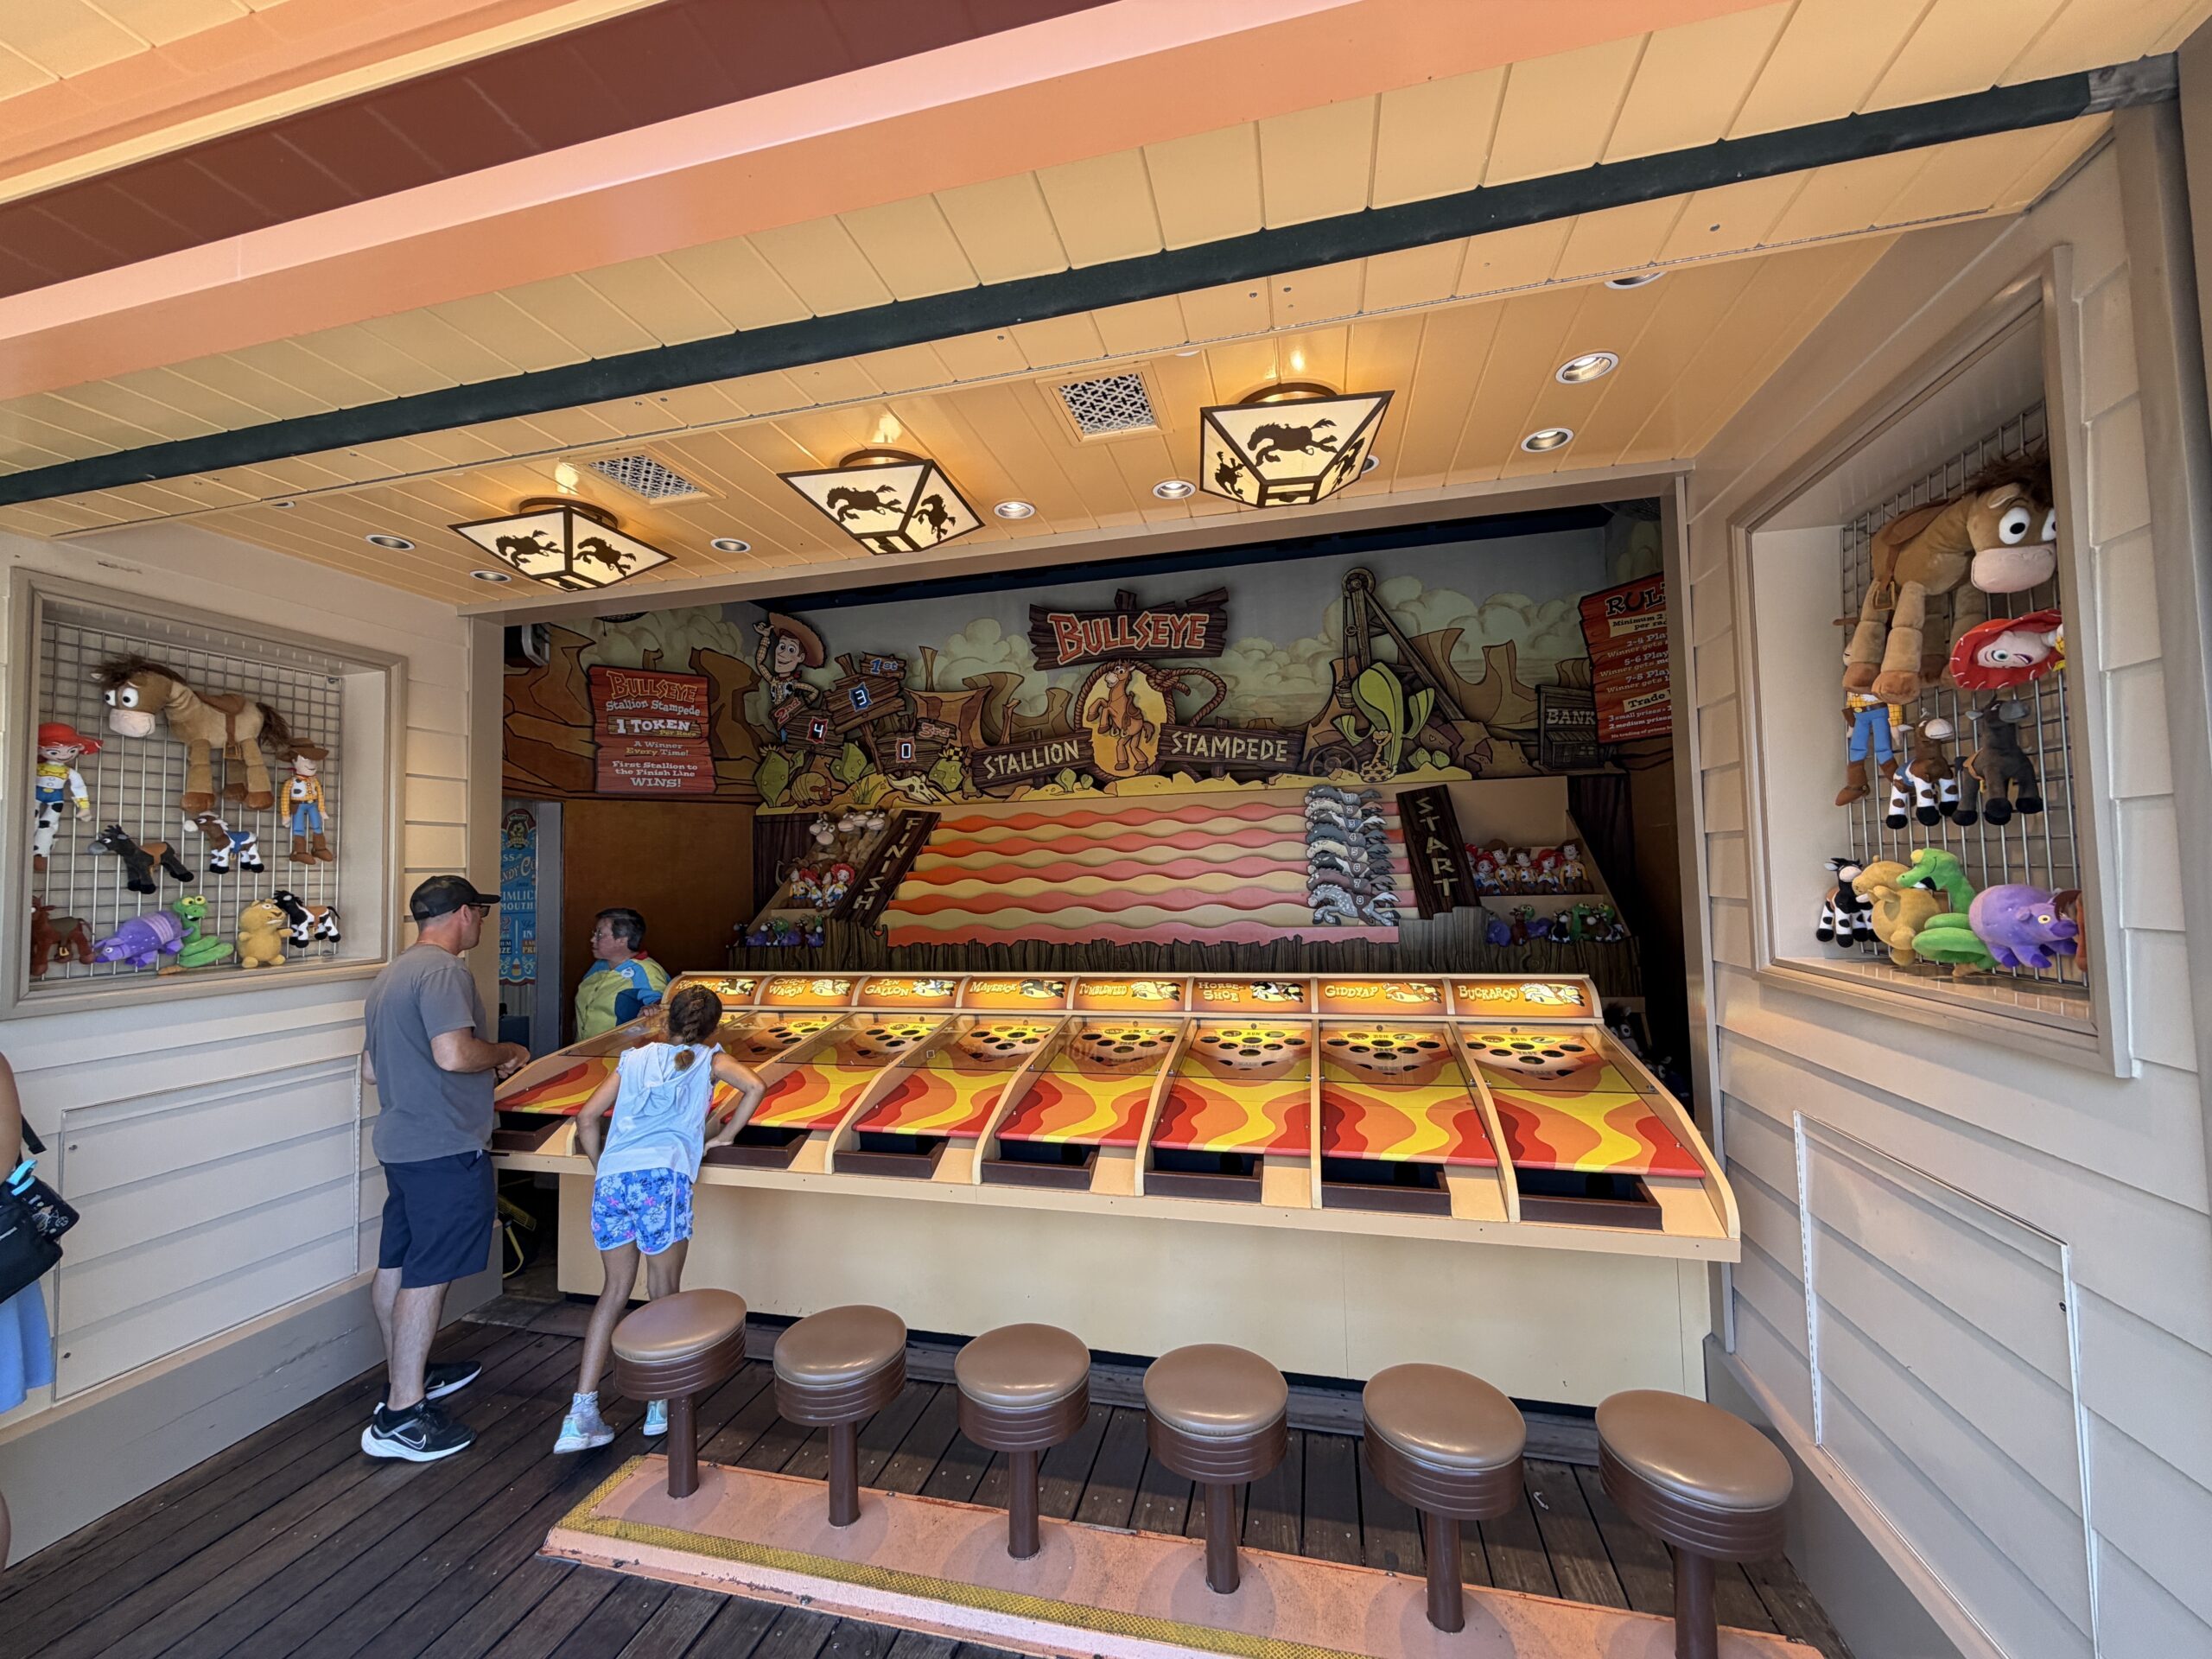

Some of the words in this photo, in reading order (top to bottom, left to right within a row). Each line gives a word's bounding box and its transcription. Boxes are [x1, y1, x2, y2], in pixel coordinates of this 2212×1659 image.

[1612, 616, 1655, 626] Minimum
[1046, 611, 1209, 666] BULLSEYE
[1606, 645, 1639, 658] Winner
[1642, 641, 1663, 652] gets
[869, 658, 899, 675] 1st
[1599, 665, 1632, 677] Winner
[1634, 660, 1655, 671] gets
[1624, 657, 1642, 666] 5-6
[606, 671, 697, 703] BULLSEYE
[1606, 683, 1639, 693] Winner
[1642, 677, 1662, 687] gets
[855, 690, 868, 706] 3
[1628, 693, 1665, 709] Trade
[606, 698, 649, 711] Stallion
[651, 699, 701, 716] Stampede
[774, 697, 801, 724] 2nd
[1546, 709, 1596, 725] BANK
[1615, 712, 1635, 721] small
[616, 718, 626, 734] 1
[630, 719, 691, 733] TOKEN
[813, 723, 824, 739] 4
[918, 722, 950, 738] 3rd
[626, 747, 659, 756] Every
[901, 743, 912, 759] 0
[1171, 730, 1289, 762] STAMPEDE
[642, 761, 685, 770] Stallion
[983, 740, 1080, 779] STALLION
[672, 769, 696, 778] Line
[630, 777, 682, 788] WINS!
[1415, 796, 1459, 897] START
[852, 817, 923, 910] FINISH
[1353, 879, 1362, 887] 7
[500, 890, 537, 901] IMLIC
[1356, 896, 1363, 905] 8
[769, 985, 805, 997] WAGON
[864, 984, 909, 997] GALLON
[969, 981, 1018, 995] MAVERICK
[1079, 983, 1128, 997] TUMBLEWEED
[1203, 989, 1240, 1002] SHOE
[1457, 984, 1520, 1002] BUCKAROO
